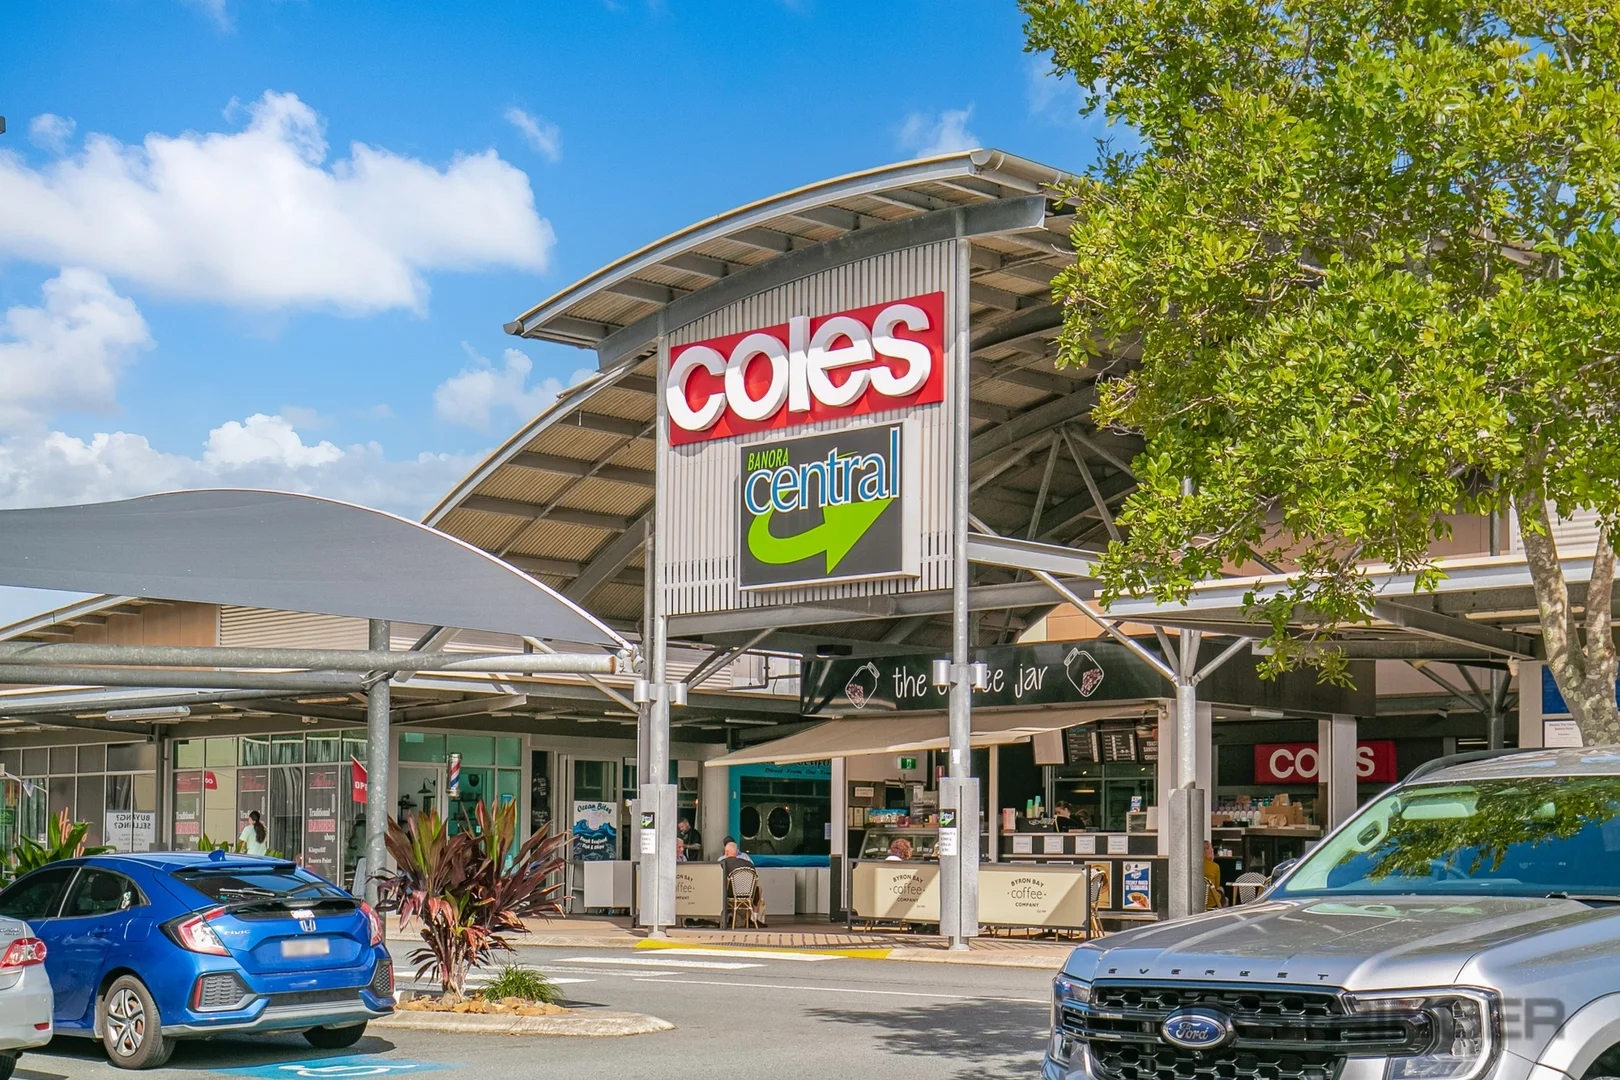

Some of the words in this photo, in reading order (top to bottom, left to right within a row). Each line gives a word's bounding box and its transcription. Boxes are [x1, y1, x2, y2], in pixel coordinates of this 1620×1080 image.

[666, 304, 932, 431] coles
[748, 447, 789, 471] BANORA
[745, 426, 900, 516] central
[893, 666, 927, 698] the
[1015, 663, 1048, 698] jar
[1269, 746, 1376, 778] COS
[355, 781, 367, 792] OPE
[892, 874, 912, 883] BYRON
[912, 875, 924, 884] BAY
[1010, 878, 1031, 887] BYRON
[1032, 878, 1044, 888] BAY
[676, 881, 692, 893] ffee
[893, 883, 922, 895] coffee
[1011, 887, 1043, 900] coffee
[1108, 968, 1329, 980] EVEREST
[1175, 1021, 1209, 1041] Ford
